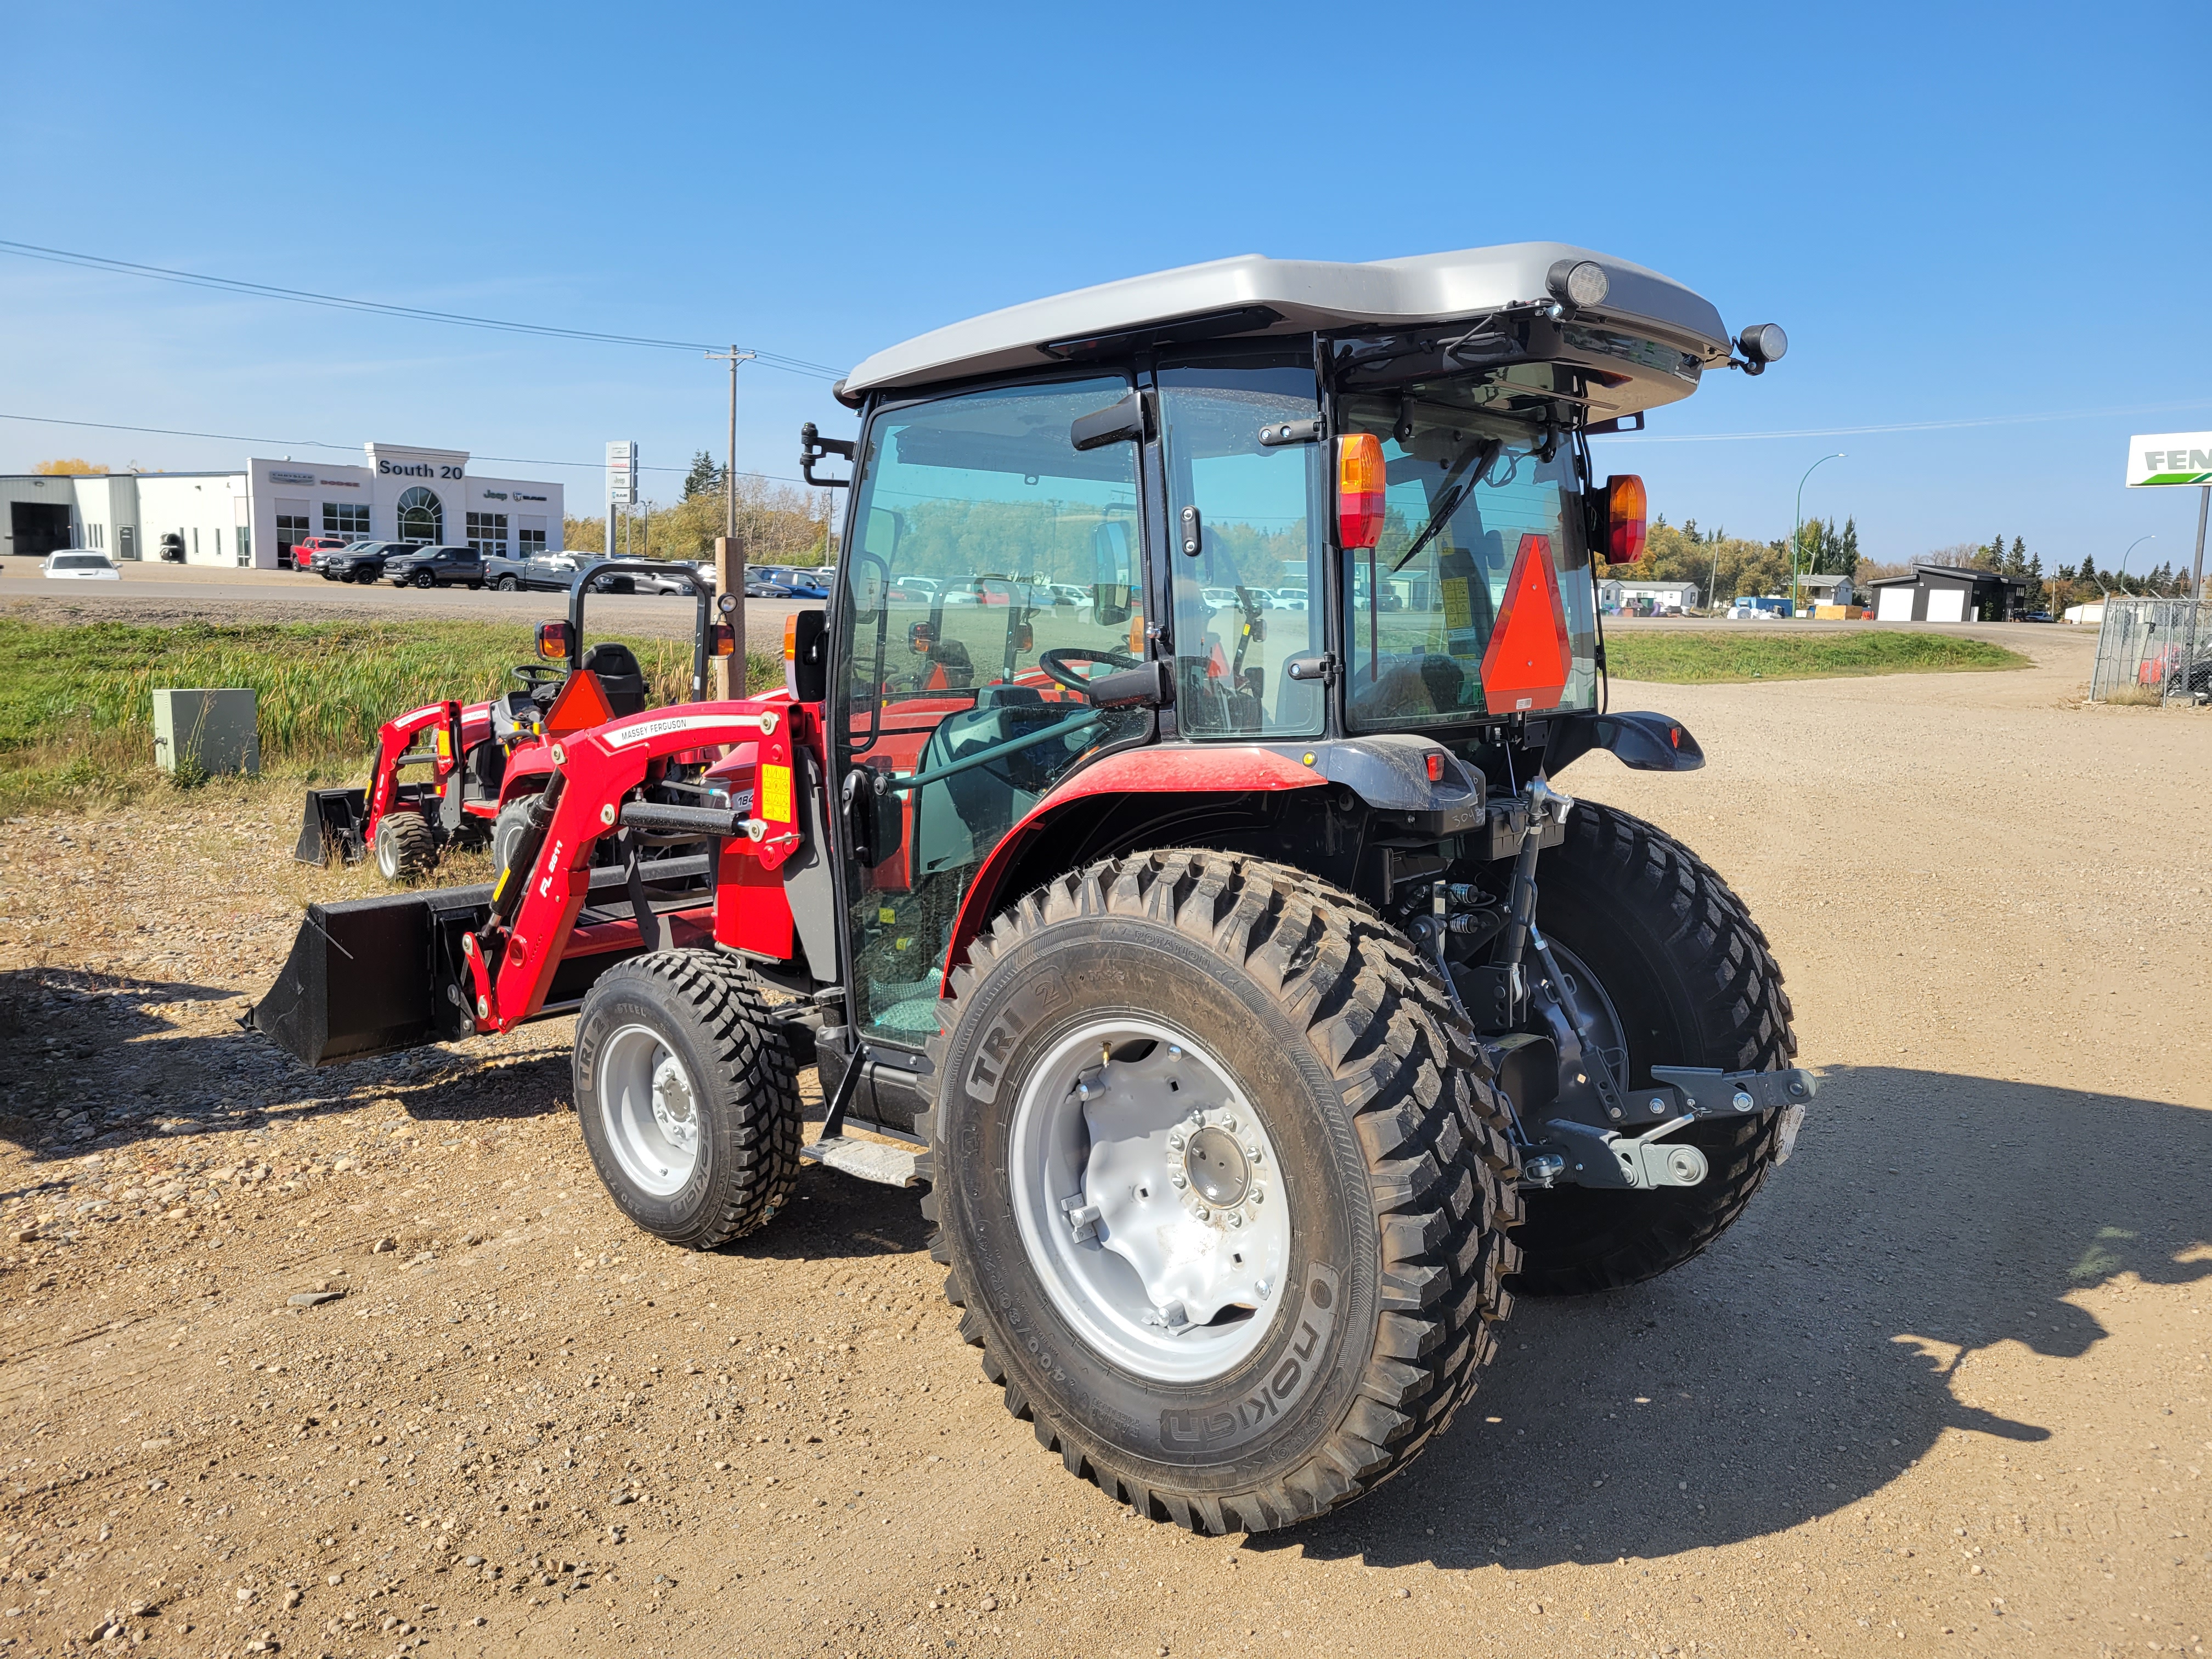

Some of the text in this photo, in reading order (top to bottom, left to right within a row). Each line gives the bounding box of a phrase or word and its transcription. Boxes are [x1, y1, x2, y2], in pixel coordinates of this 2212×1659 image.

[379, 460, 462, 479] South 20
[2145, 449, 2212, 471] FEN
[622, 719, 687, 741] MASSEY FERGUSON
[539, 839, 563, 898] FL 2611
[1135, 930, 1211, 969] ROTATION
[1088, 970, 1126, 982] M+S
[616, 1003, 647, 1018] STEEL
[579, 1017, 606, 1081] TRI 2
[970, 1007, 1027, 1087] TRI
[1035, 980, 1061, 1008] 2
[1170, 1319, 1320, 1442] nokian
[1091, 1404, 1139, 1438] RADIAL
[1093, 1397, 1140, 1426] TUBELESS
[1267, 1406, 1330, 1462] ROTATION
